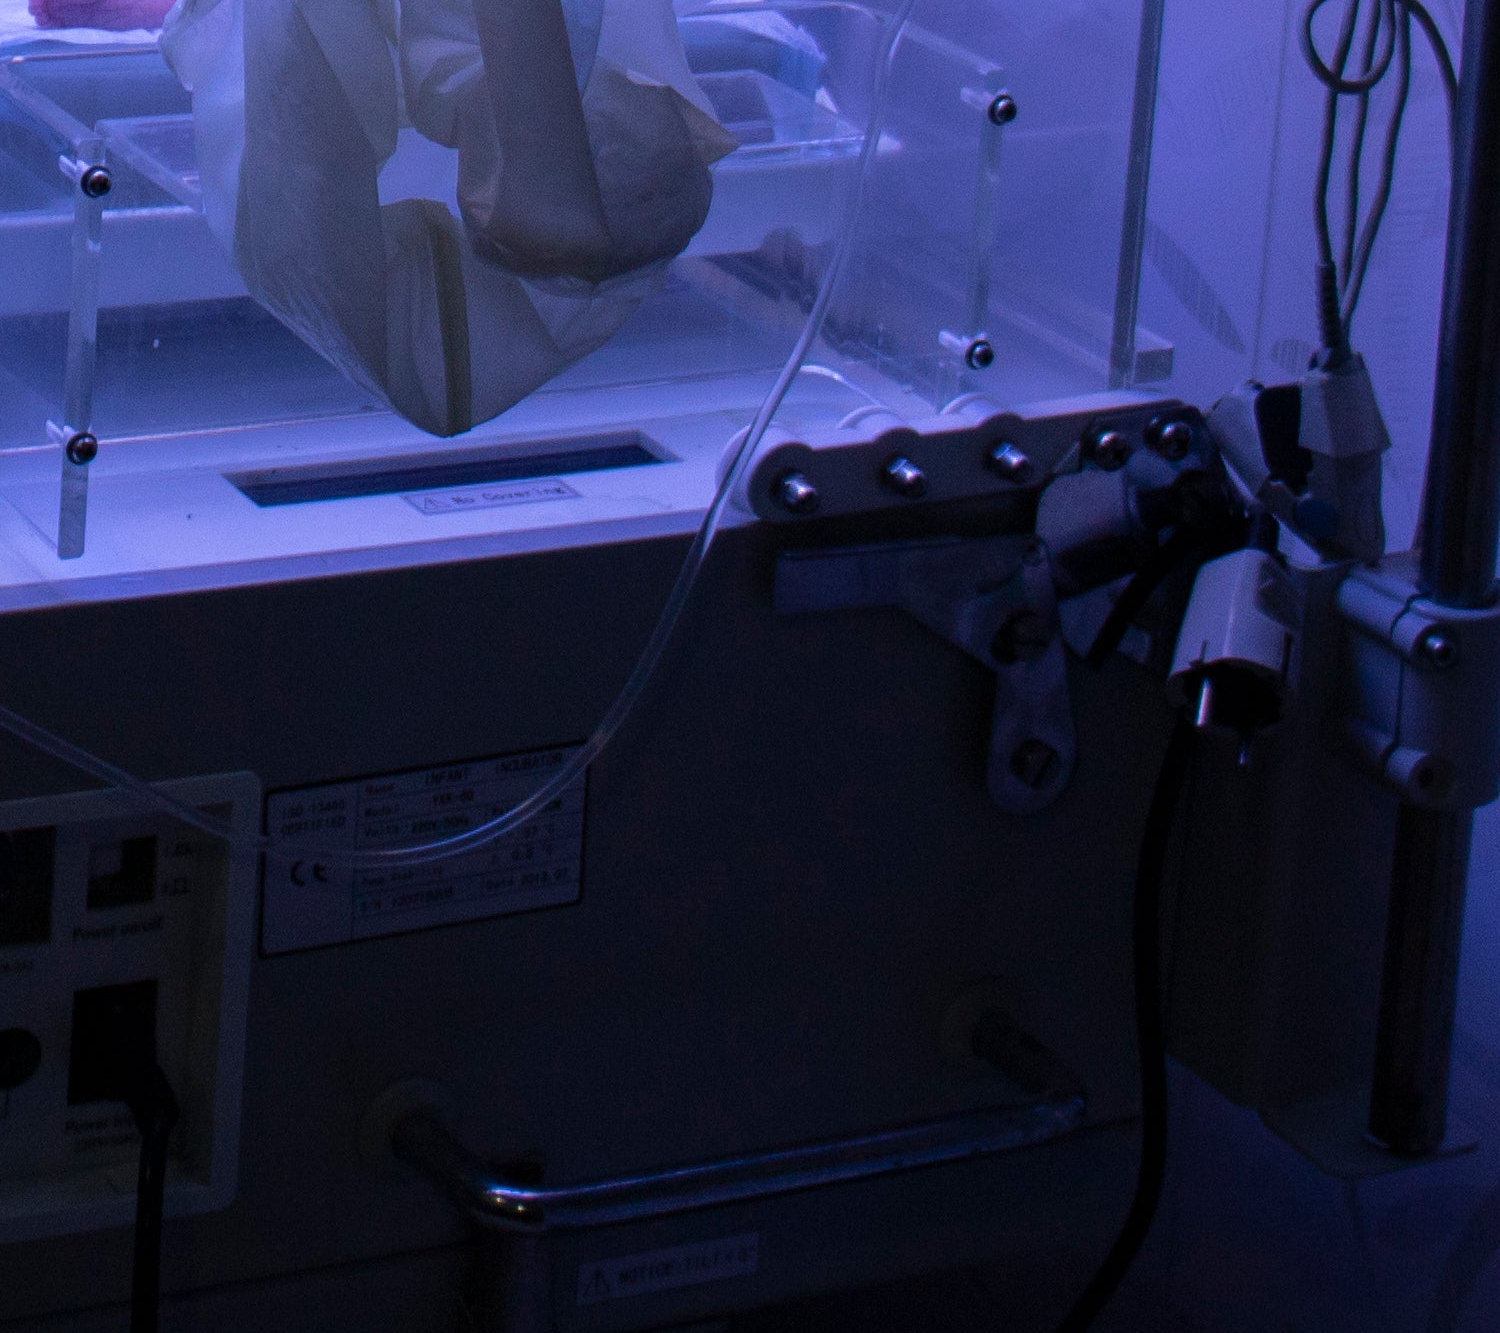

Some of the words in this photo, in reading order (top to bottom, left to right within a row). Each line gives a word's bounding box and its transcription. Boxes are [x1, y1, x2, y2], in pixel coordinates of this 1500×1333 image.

[424, 766, 471, 786] INFANT
[495, 752, 563, 775] INCUBATOR
[72, 922, 116, 943] Power
[64, 1118, 111, 1135] Power
